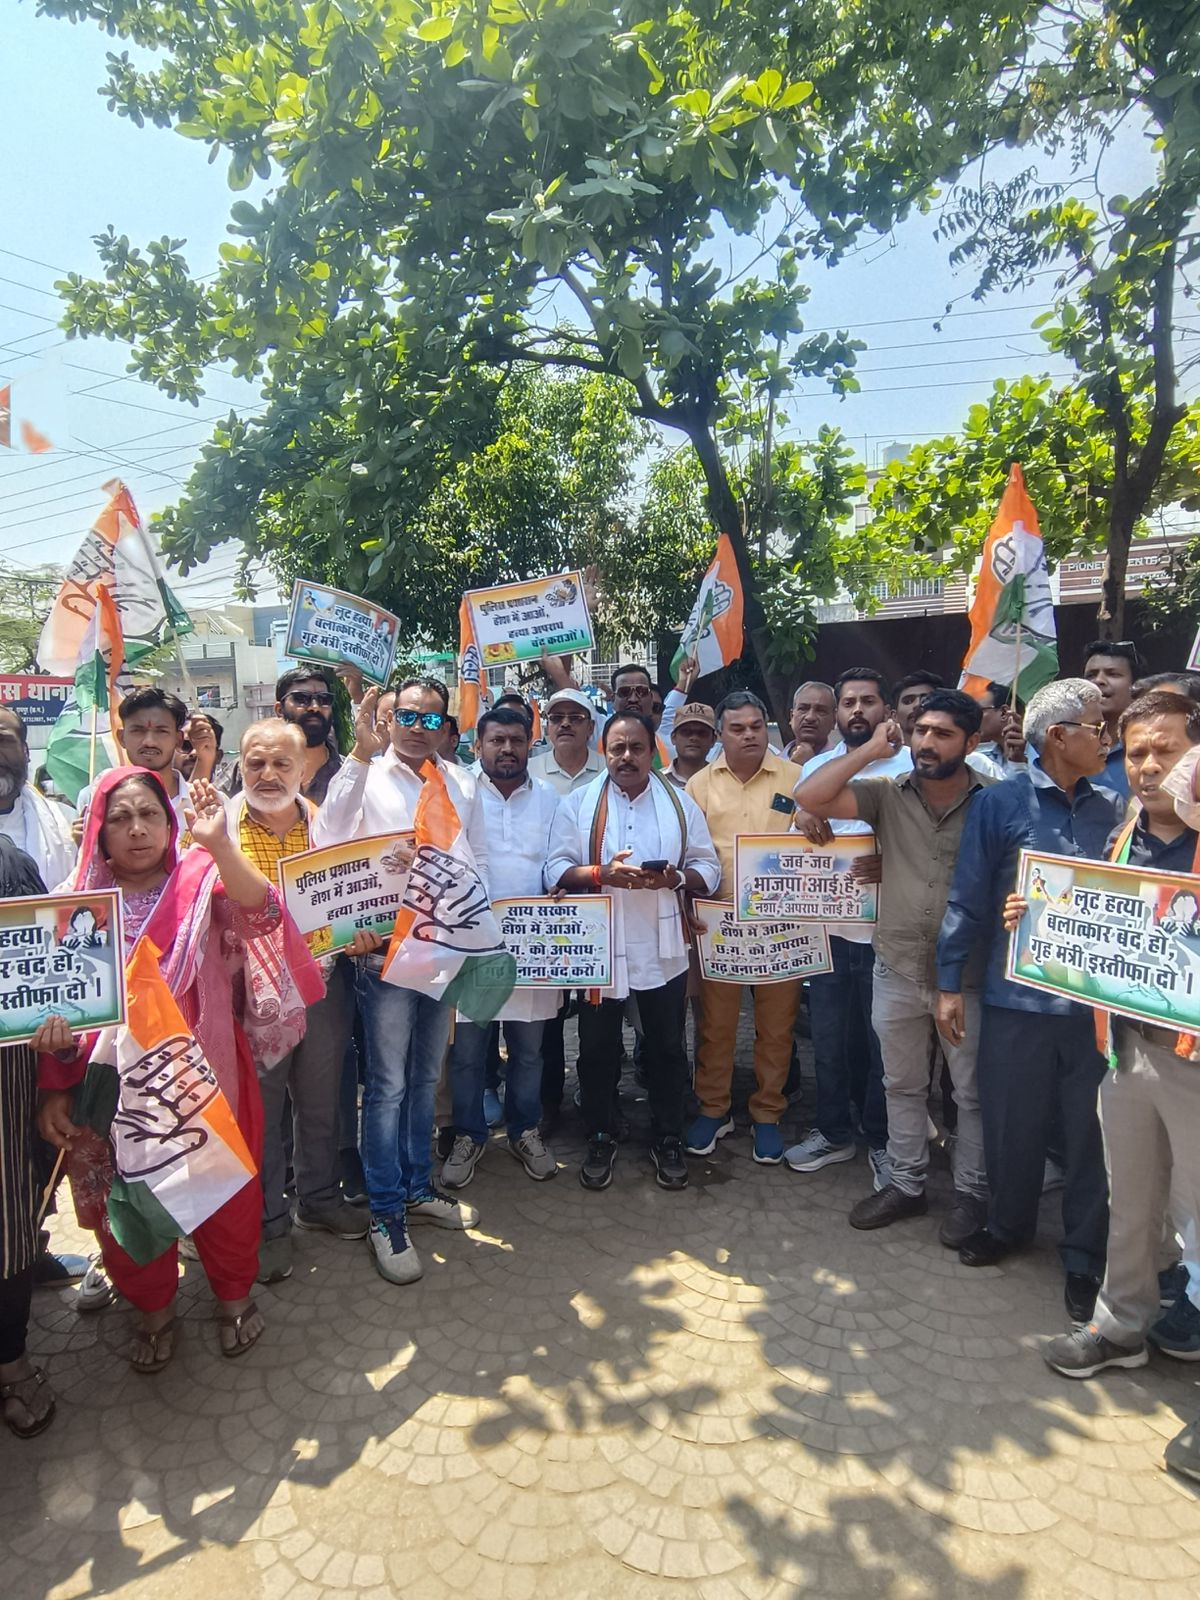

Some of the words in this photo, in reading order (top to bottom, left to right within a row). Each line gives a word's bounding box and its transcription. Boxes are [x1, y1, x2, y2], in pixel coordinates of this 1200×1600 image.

[28, 683, 67, 701] थान
[781, 855, 833, 869] जब-जब
[296, 870, 327, 894] पुलिस
[329, 857, 371, 880] प्रशासन
[754, 876, 802, 892] भाजपा
[807, 873, 839, 895] आई
[310, 889, 331, 906] होश
[333, 881, 344, 898] में
[326, 904, 353, 921] हत्या
[357, 893, 399, 912] अपराध
[507, 905, 534, 917] साय
[537, 905, 578, 917] सरकार
[755, 902, 780, 915] नशा,
[784, 902, 818, 914] अपराध
[822, 901, 843, 915] लाई
[1074, 889, 1101, 916] लूट
[1104, 894, 1145, 918] हत्या
[353, 914, 373, 929] बंद
[501, 920, 527, 935] होश
[530, 921, 543, 935] में
[720, 923, 743, 938] होश
[747, 924, 759, 937] में
[1047, 913, 1113, 944] बलात्कार
[1116, 923, 1144, 950] बंद
[529, 942, 547, 955] को
[749, 943, 765, 956] को
[16, 951, 47, 976] बंद
[517, 965, 547, 978] नाना
[550, 962, 569, 977] बंद
[571, 962, 596, 977] करों
[771, 958, 789, 972] बंद
[791, 951, 814, 967] करों
[1031, 938, 1053, 964] गृह
[1055, 941, 1084, 968] मंत्री
[1088, 951, 1151, 984] इस्तीफा
[1155, 963, 1178, 991] दो
[65, 977, 87, 1000] दो
